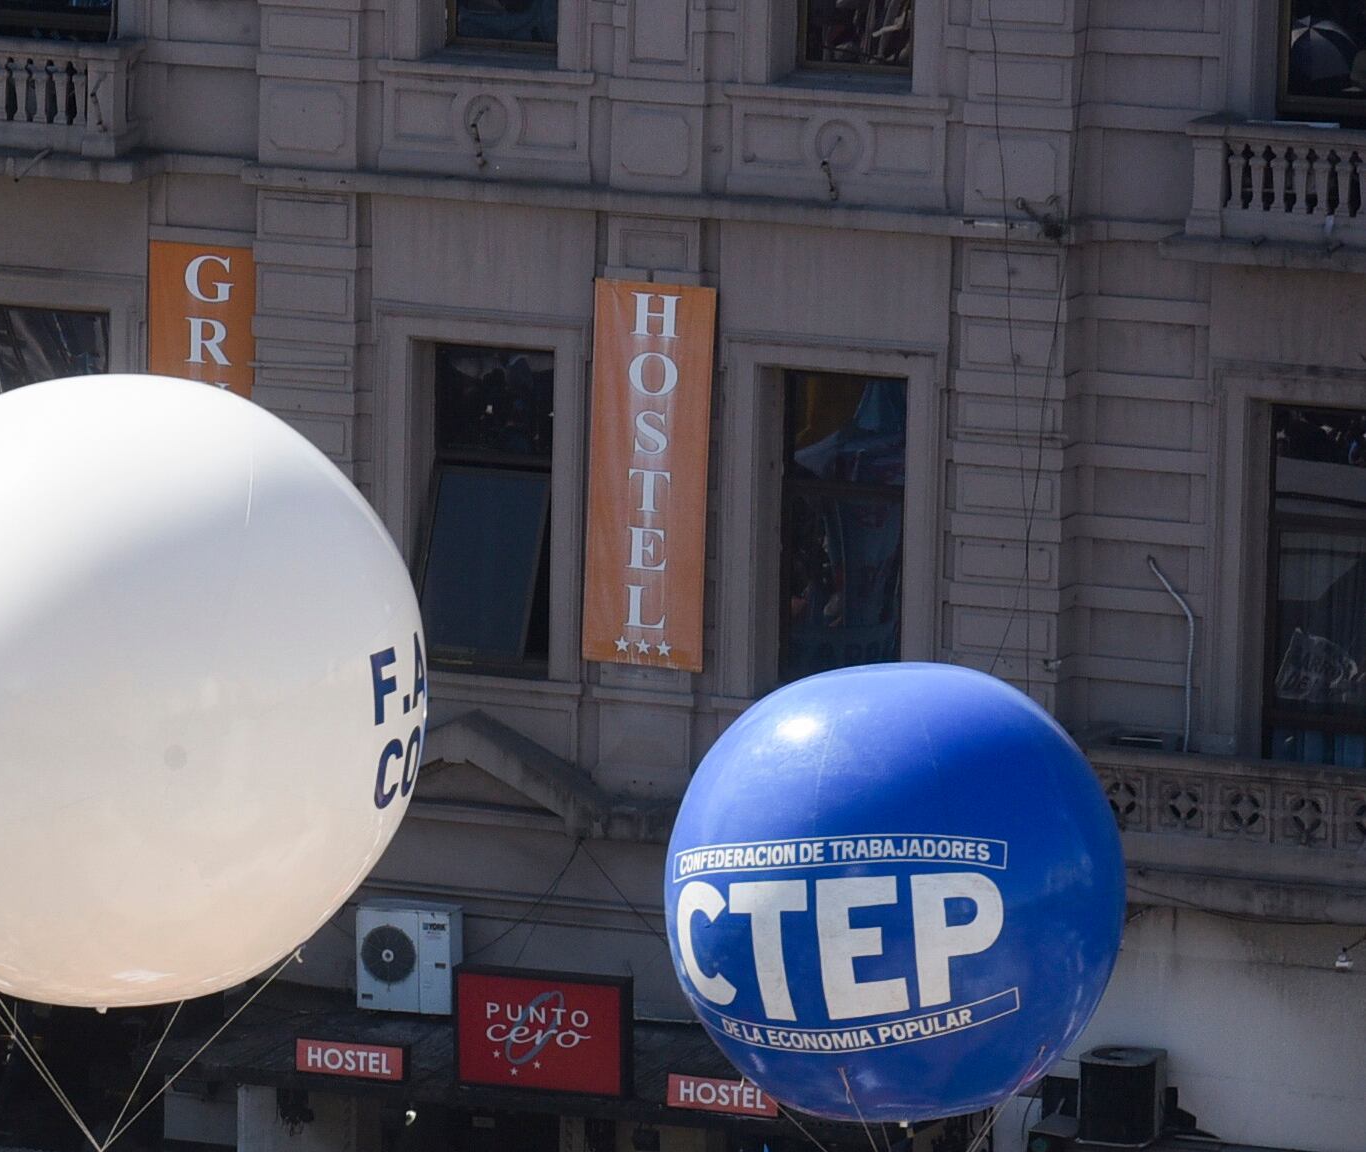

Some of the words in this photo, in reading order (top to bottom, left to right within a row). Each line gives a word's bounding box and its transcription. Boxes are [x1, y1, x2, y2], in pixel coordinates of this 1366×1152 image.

[624, 290, 680, 631] HOSTEL
[679, 842, 796, 874] CONFEDERACION
[799, 840, 824, 863] DE
[829, 838, 991, 864] TRABAJADORES
[676, 871, 1005, 1022] CTEP
[485, 1001, 590, 1028] PUNTO
[722, 1017, 743, 1038] DE
[743, 1024, 764, 1046] LA
[766, 1028, 873, 1052] ECONOMIA
[876, 1009, 972, 1046] POPULAR
[485, 1019, 591, 1049] cero
[306, 1046, 391, 1075] HOSTEL
[679, 1080, 767, 1110] HOSTEL
